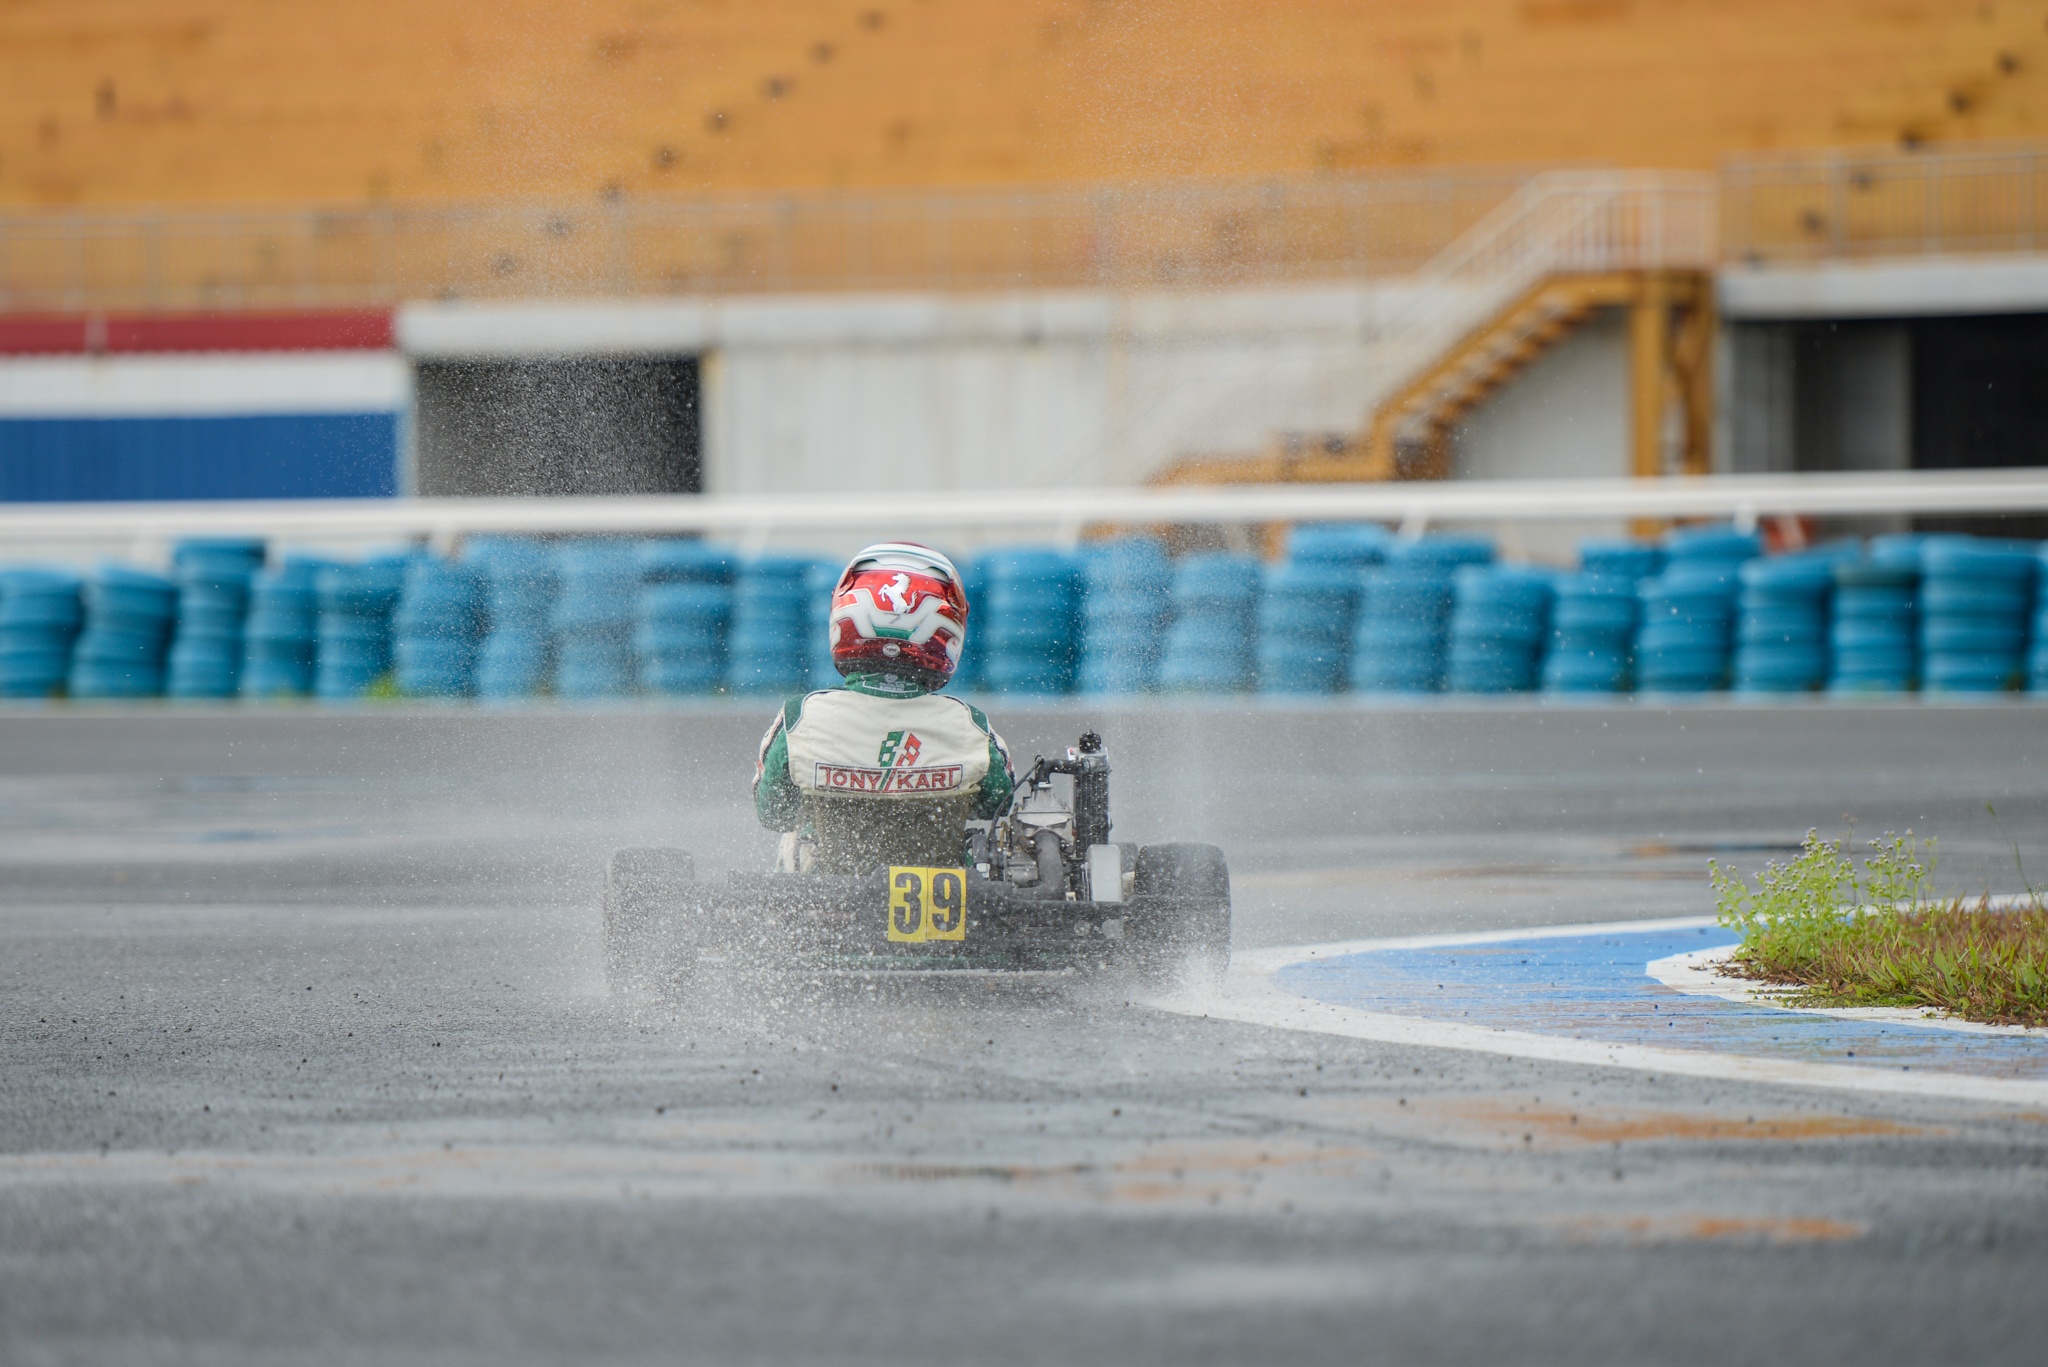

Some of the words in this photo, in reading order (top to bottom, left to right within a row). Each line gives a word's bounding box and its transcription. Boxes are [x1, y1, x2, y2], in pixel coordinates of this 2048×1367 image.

[819, 766, 882, 790] TONY
[898, 767, 961, 789] KART
[894, 872, 961, 934] 39
